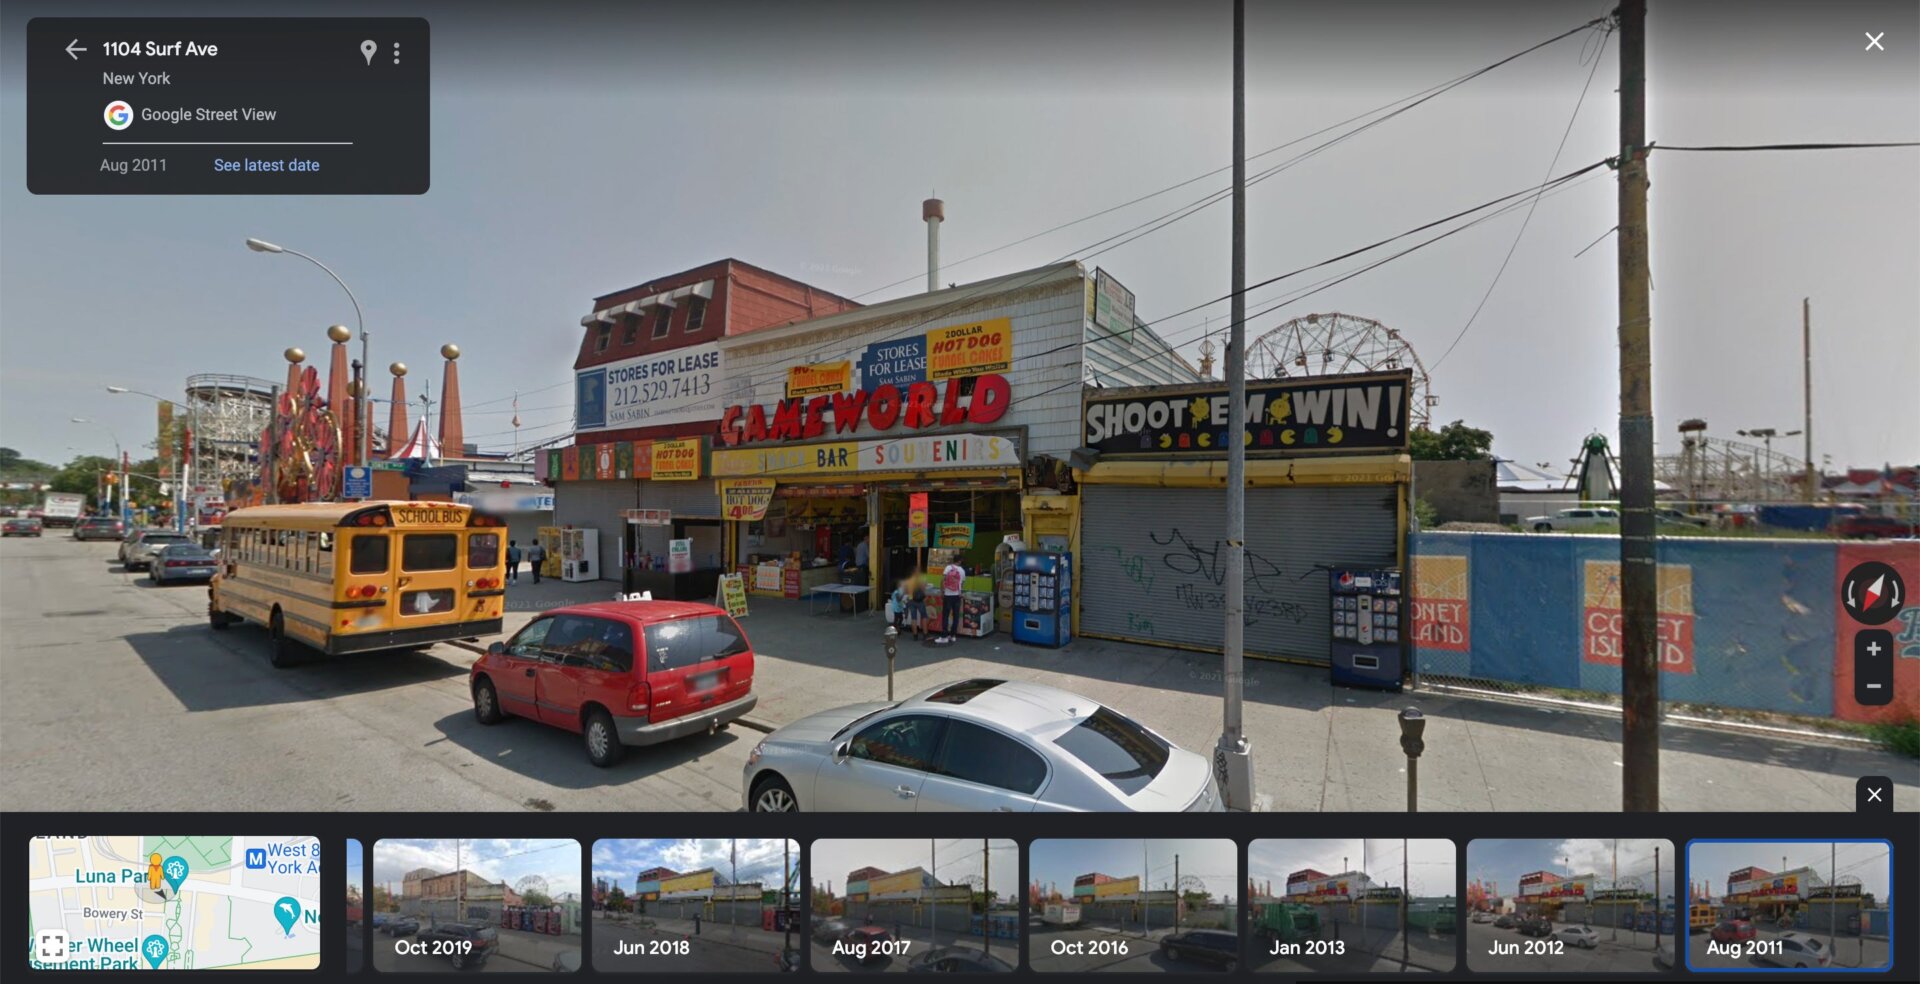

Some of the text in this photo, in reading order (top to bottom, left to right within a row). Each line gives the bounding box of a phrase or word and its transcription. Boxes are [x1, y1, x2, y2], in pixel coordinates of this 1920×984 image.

[877, 343, 919, 361] STORES
[933, 332, 1002, 354] HOT DOG
[608, 351, 719, 385] STORES FOR LEASE
[869, 357, 927, 377] FOR LEASE
[614, 373, 710, 407] 212.529.7413
[609, 410, 625, 422] SAM
[627, 408, 650, 420] SABIN
[721, 374, 1011, 446] GAMEWORLD
[1086, 400, 1188, 444] SHOOT
[656, 449, 694, 459] HOT DOG
[817, 448, 849, 468] BAR
[875, 436, 1001, 465] SOUVENIRS
[398, 508, 463, 523] SCHOOL BUS
[1410, 602, 1463, 624] ONEY
[1587, 612, 1686, 641] COEY
